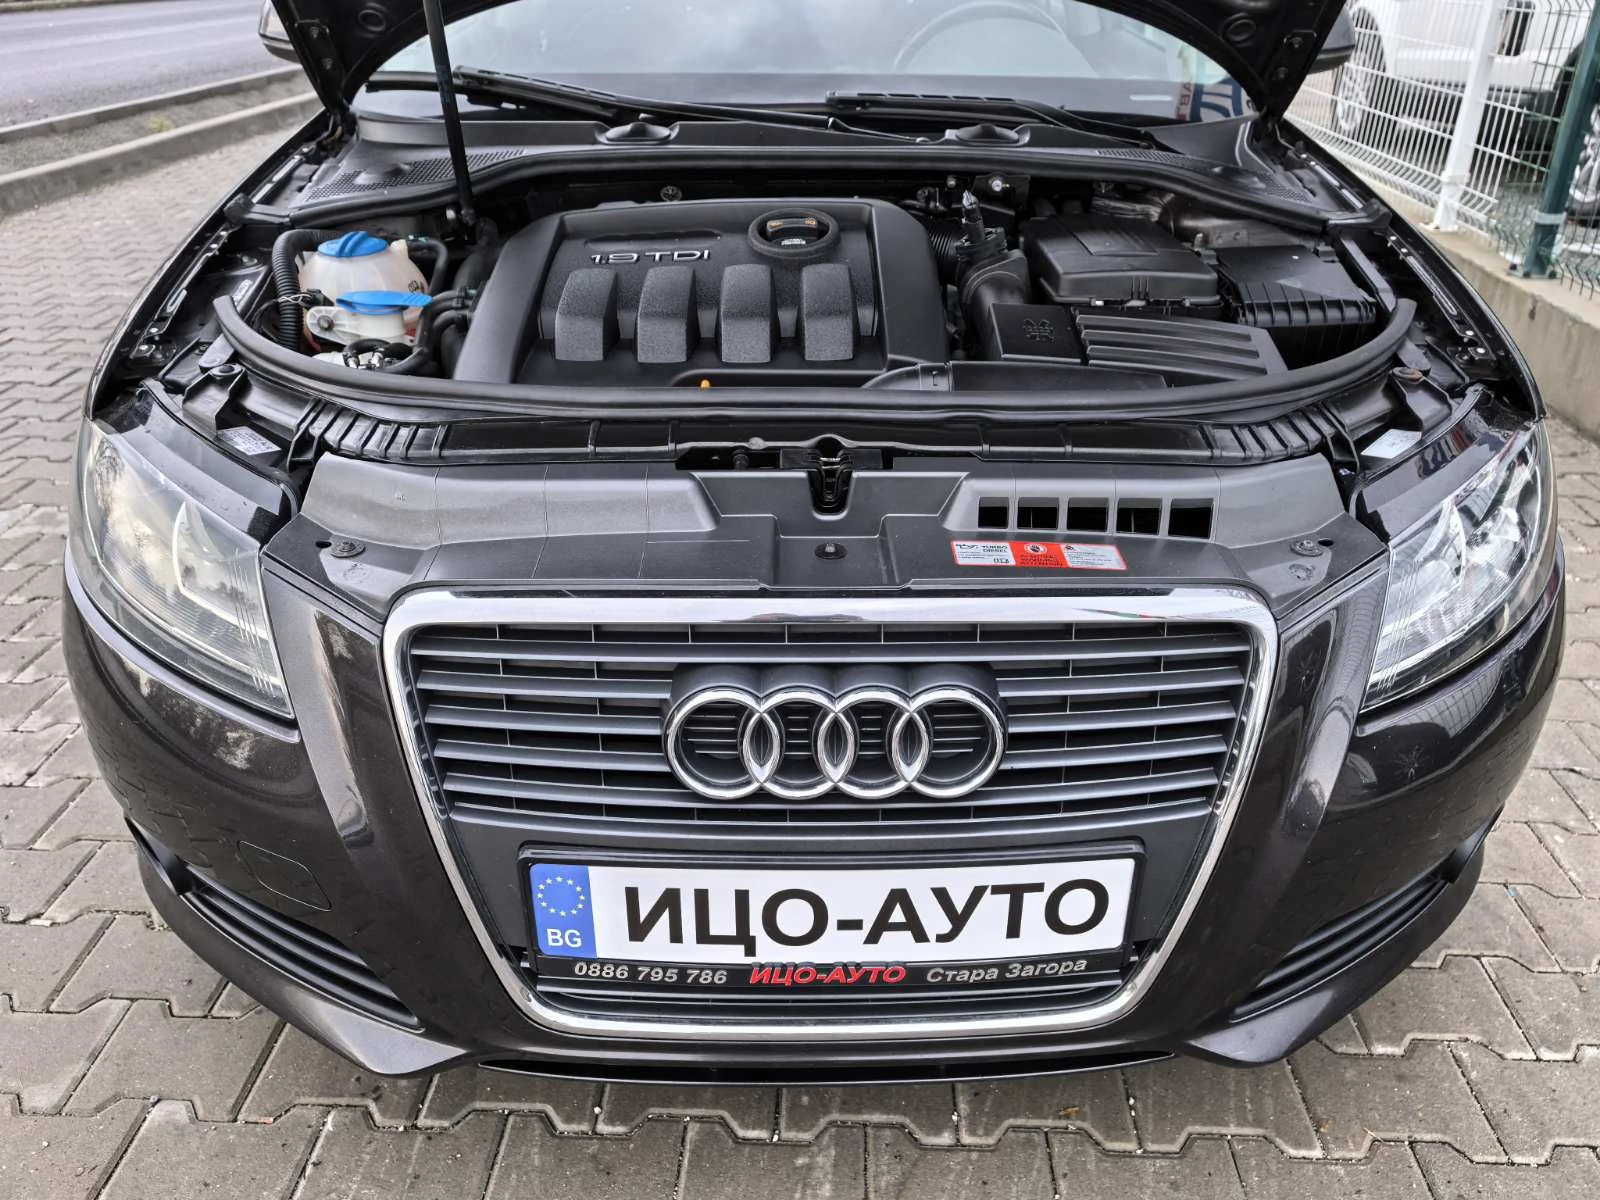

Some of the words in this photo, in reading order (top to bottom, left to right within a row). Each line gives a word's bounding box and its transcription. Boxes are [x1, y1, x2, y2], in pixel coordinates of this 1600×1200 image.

[591, 254, 640, 266] 1.9
[645, 249, 709, 264] TDI
[624, 879, 1109, 957] ИЦО-АУТО
[546, 928, 582, 948] BG
[574, 962, 629, 979] 0886
[636, 967, 678, 983] 795
[686, 969, 727, 985] 786
[749, 965, 906, 985] ИЦО-АУТО
[926, 967, 999, 983] Стара
[1004, 959, 1088, 980] Загора
